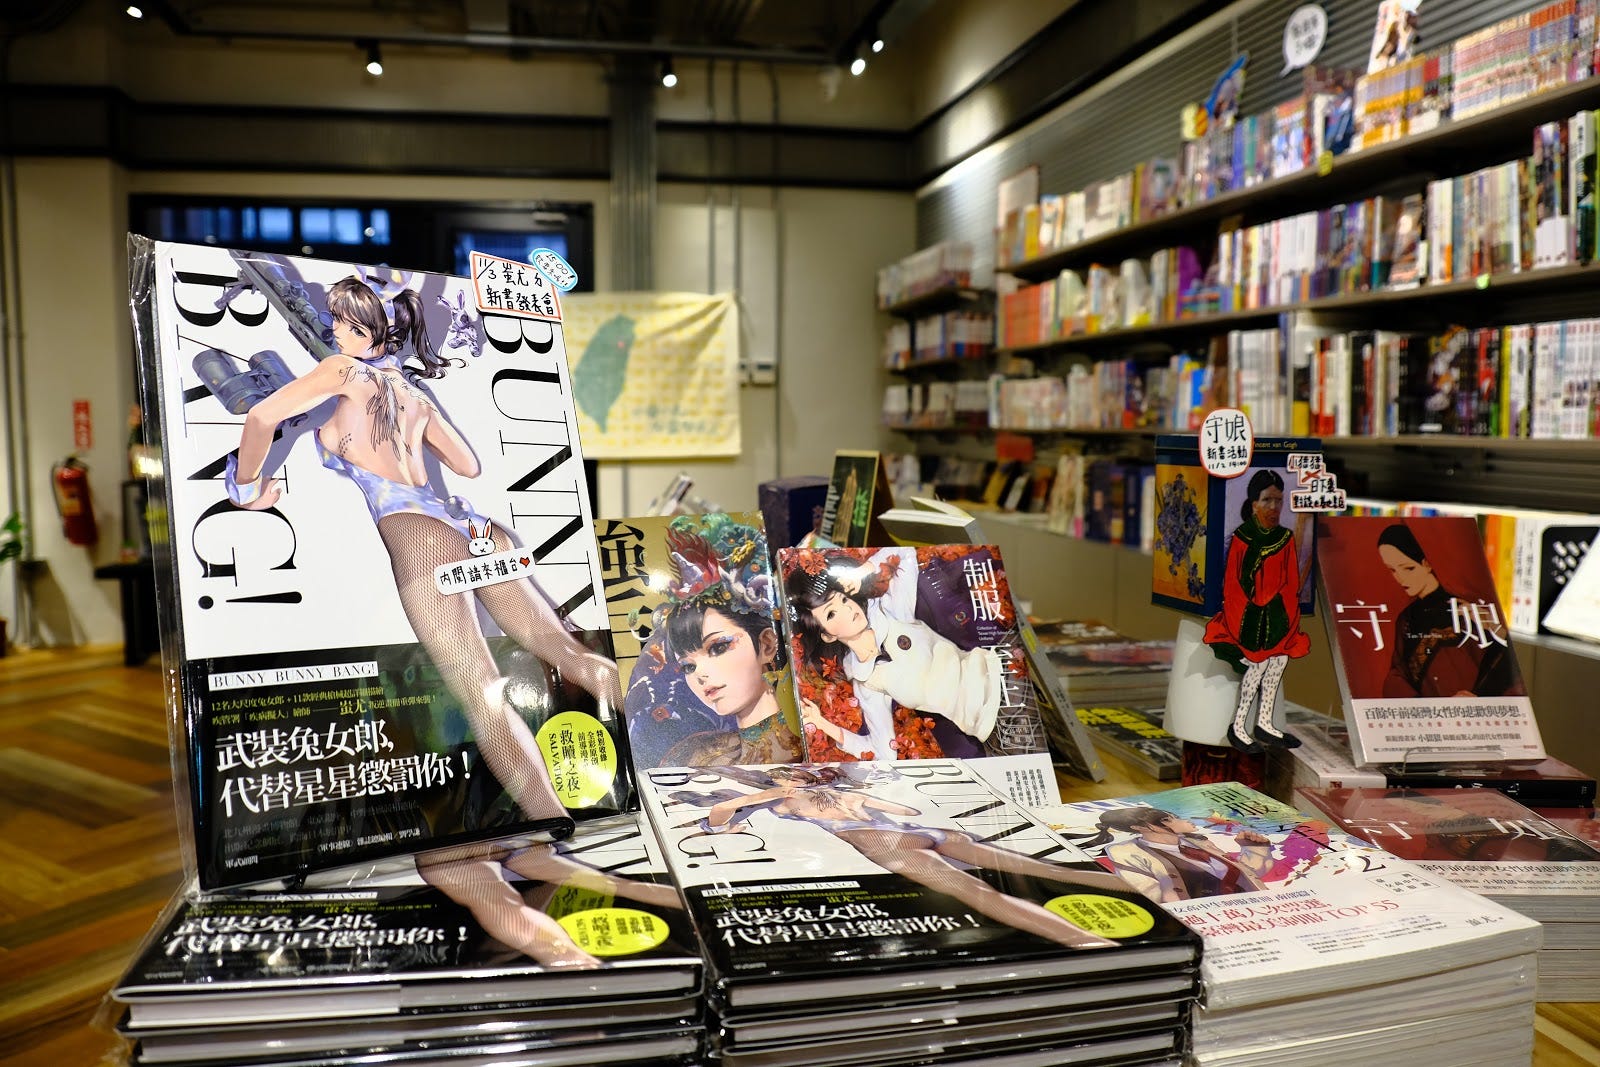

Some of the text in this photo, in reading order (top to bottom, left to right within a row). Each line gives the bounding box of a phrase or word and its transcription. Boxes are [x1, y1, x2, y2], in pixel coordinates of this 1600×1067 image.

[486, 284, 555, 316] 新書發表會
[1206, 414, 1247, 443] 守娘
[1207, 446, 1248, 460] 新書活動
[439, 557, 518, 585] 內閱請來櫃台
[1335, 597, 1509, 651] 守 娘
[213, 662, 377, 688] BUNNY BUNNY BANG!
[214, 718, 395, 773] 武裝兔女郎,
[548, 732, 565, 793] SALVATION
[219, 750, 472, 818] 代替星星懲罰你!
[1371, 899, 1401, 912] 55
